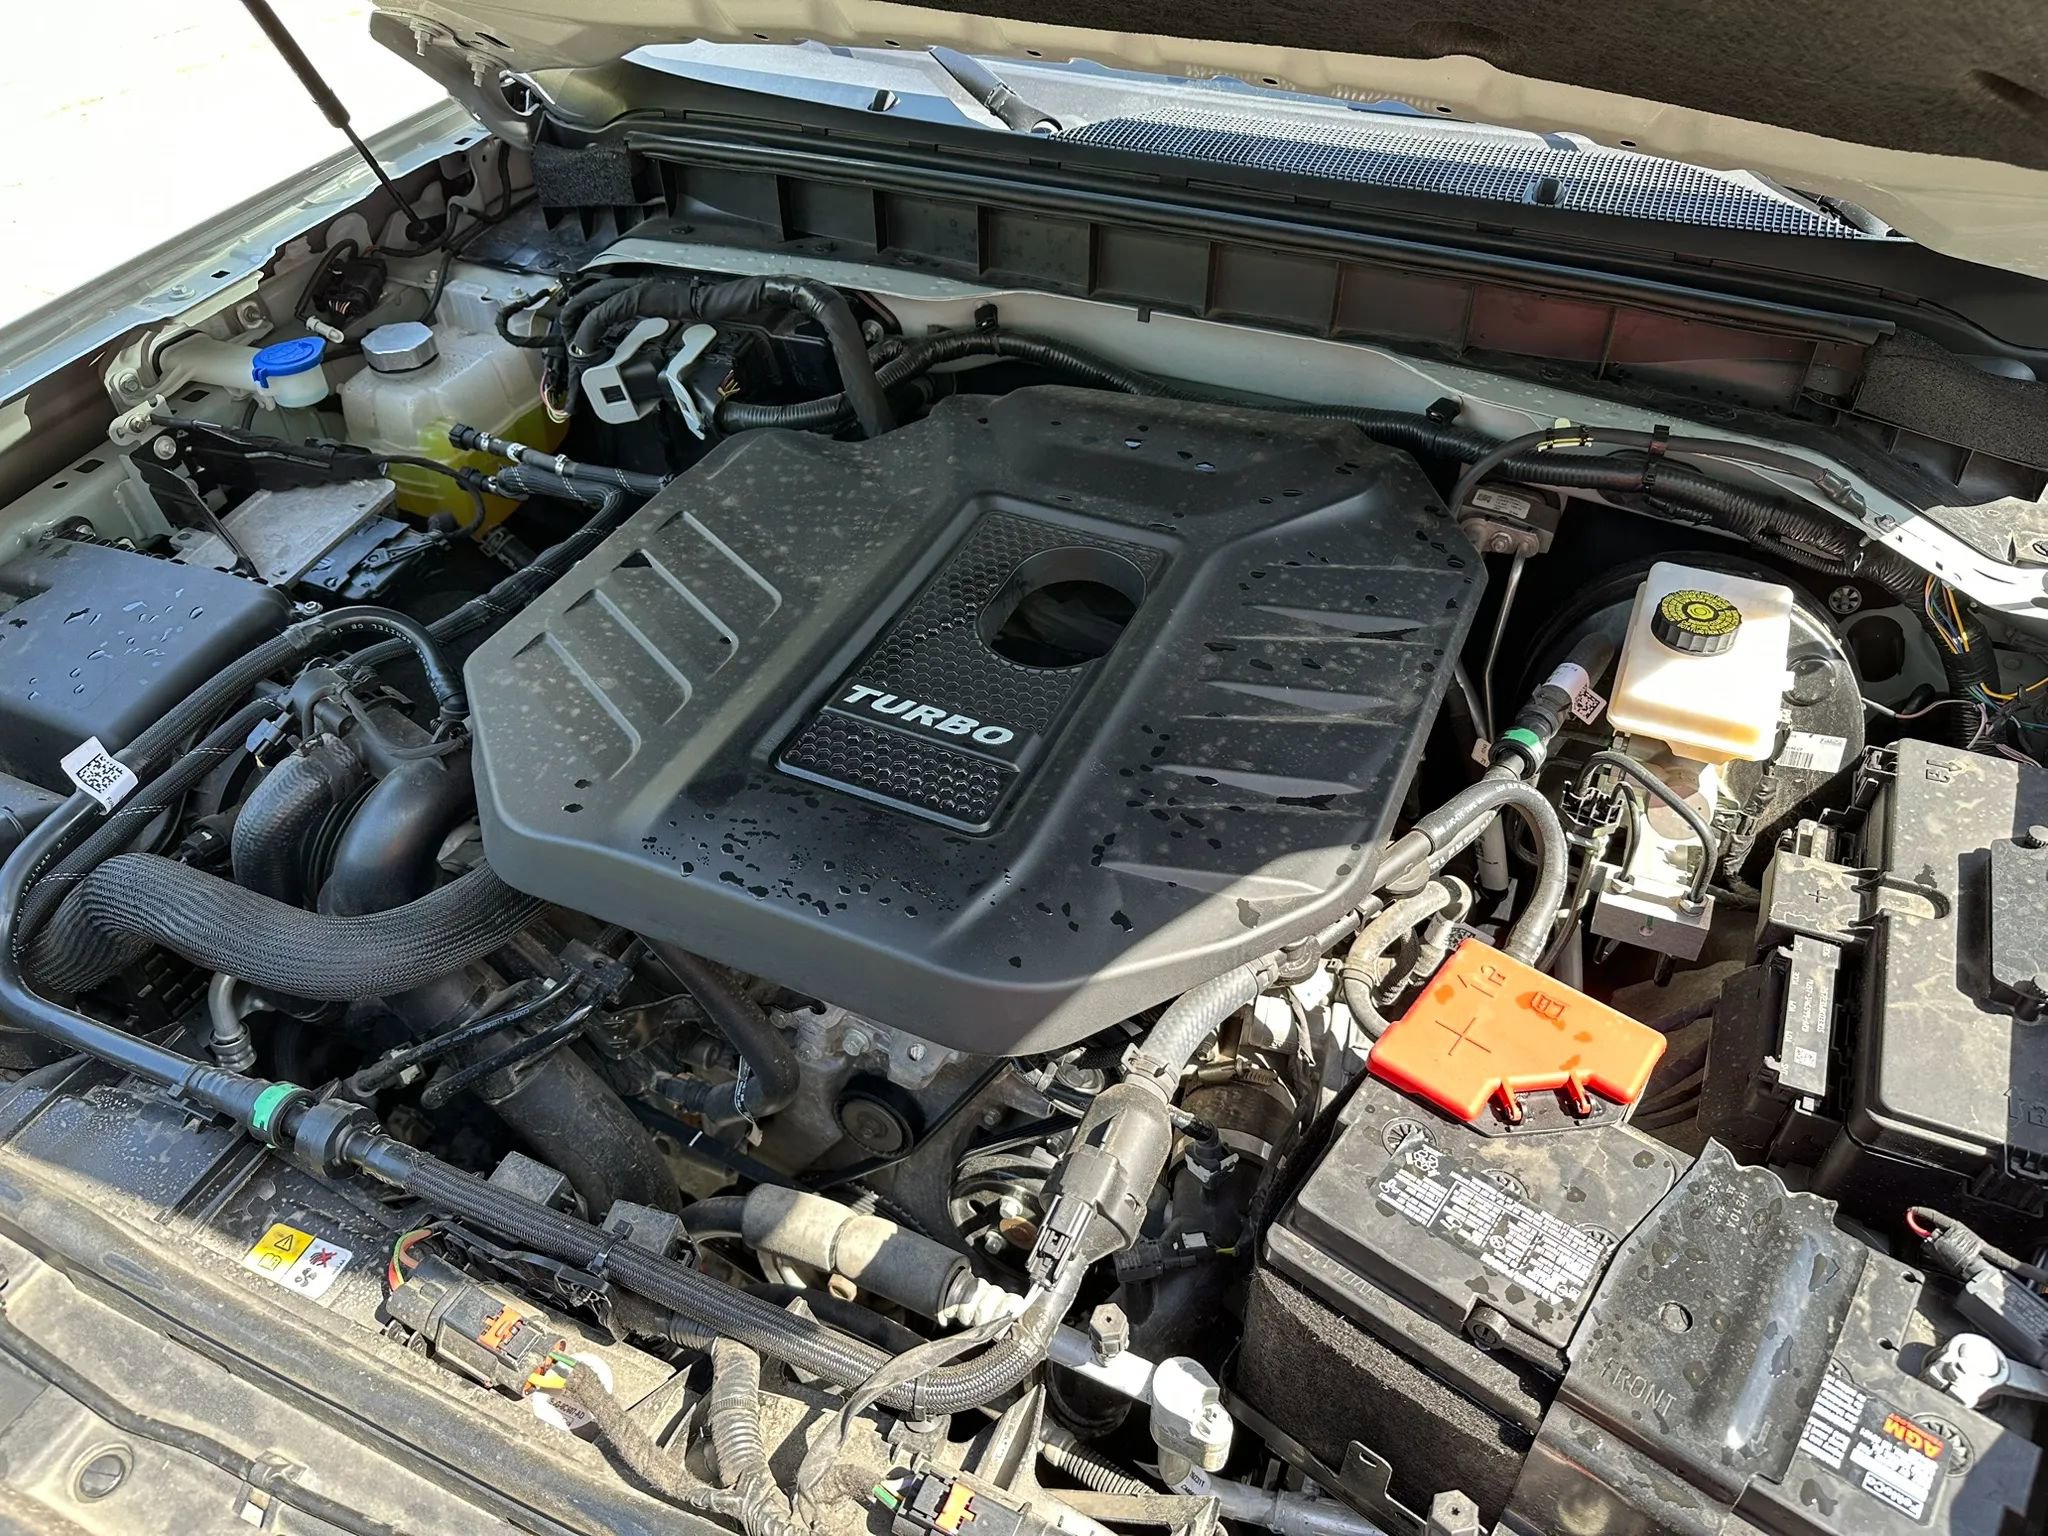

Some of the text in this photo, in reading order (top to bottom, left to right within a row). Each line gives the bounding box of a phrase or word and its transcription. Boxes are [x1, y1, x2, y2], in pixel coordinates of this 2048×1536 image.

[843, 684, 1014, 745] TURBO
[1600, 1357, 1677, 1416] FRONT
[1882, 1417, 1940, 1458] AGM
